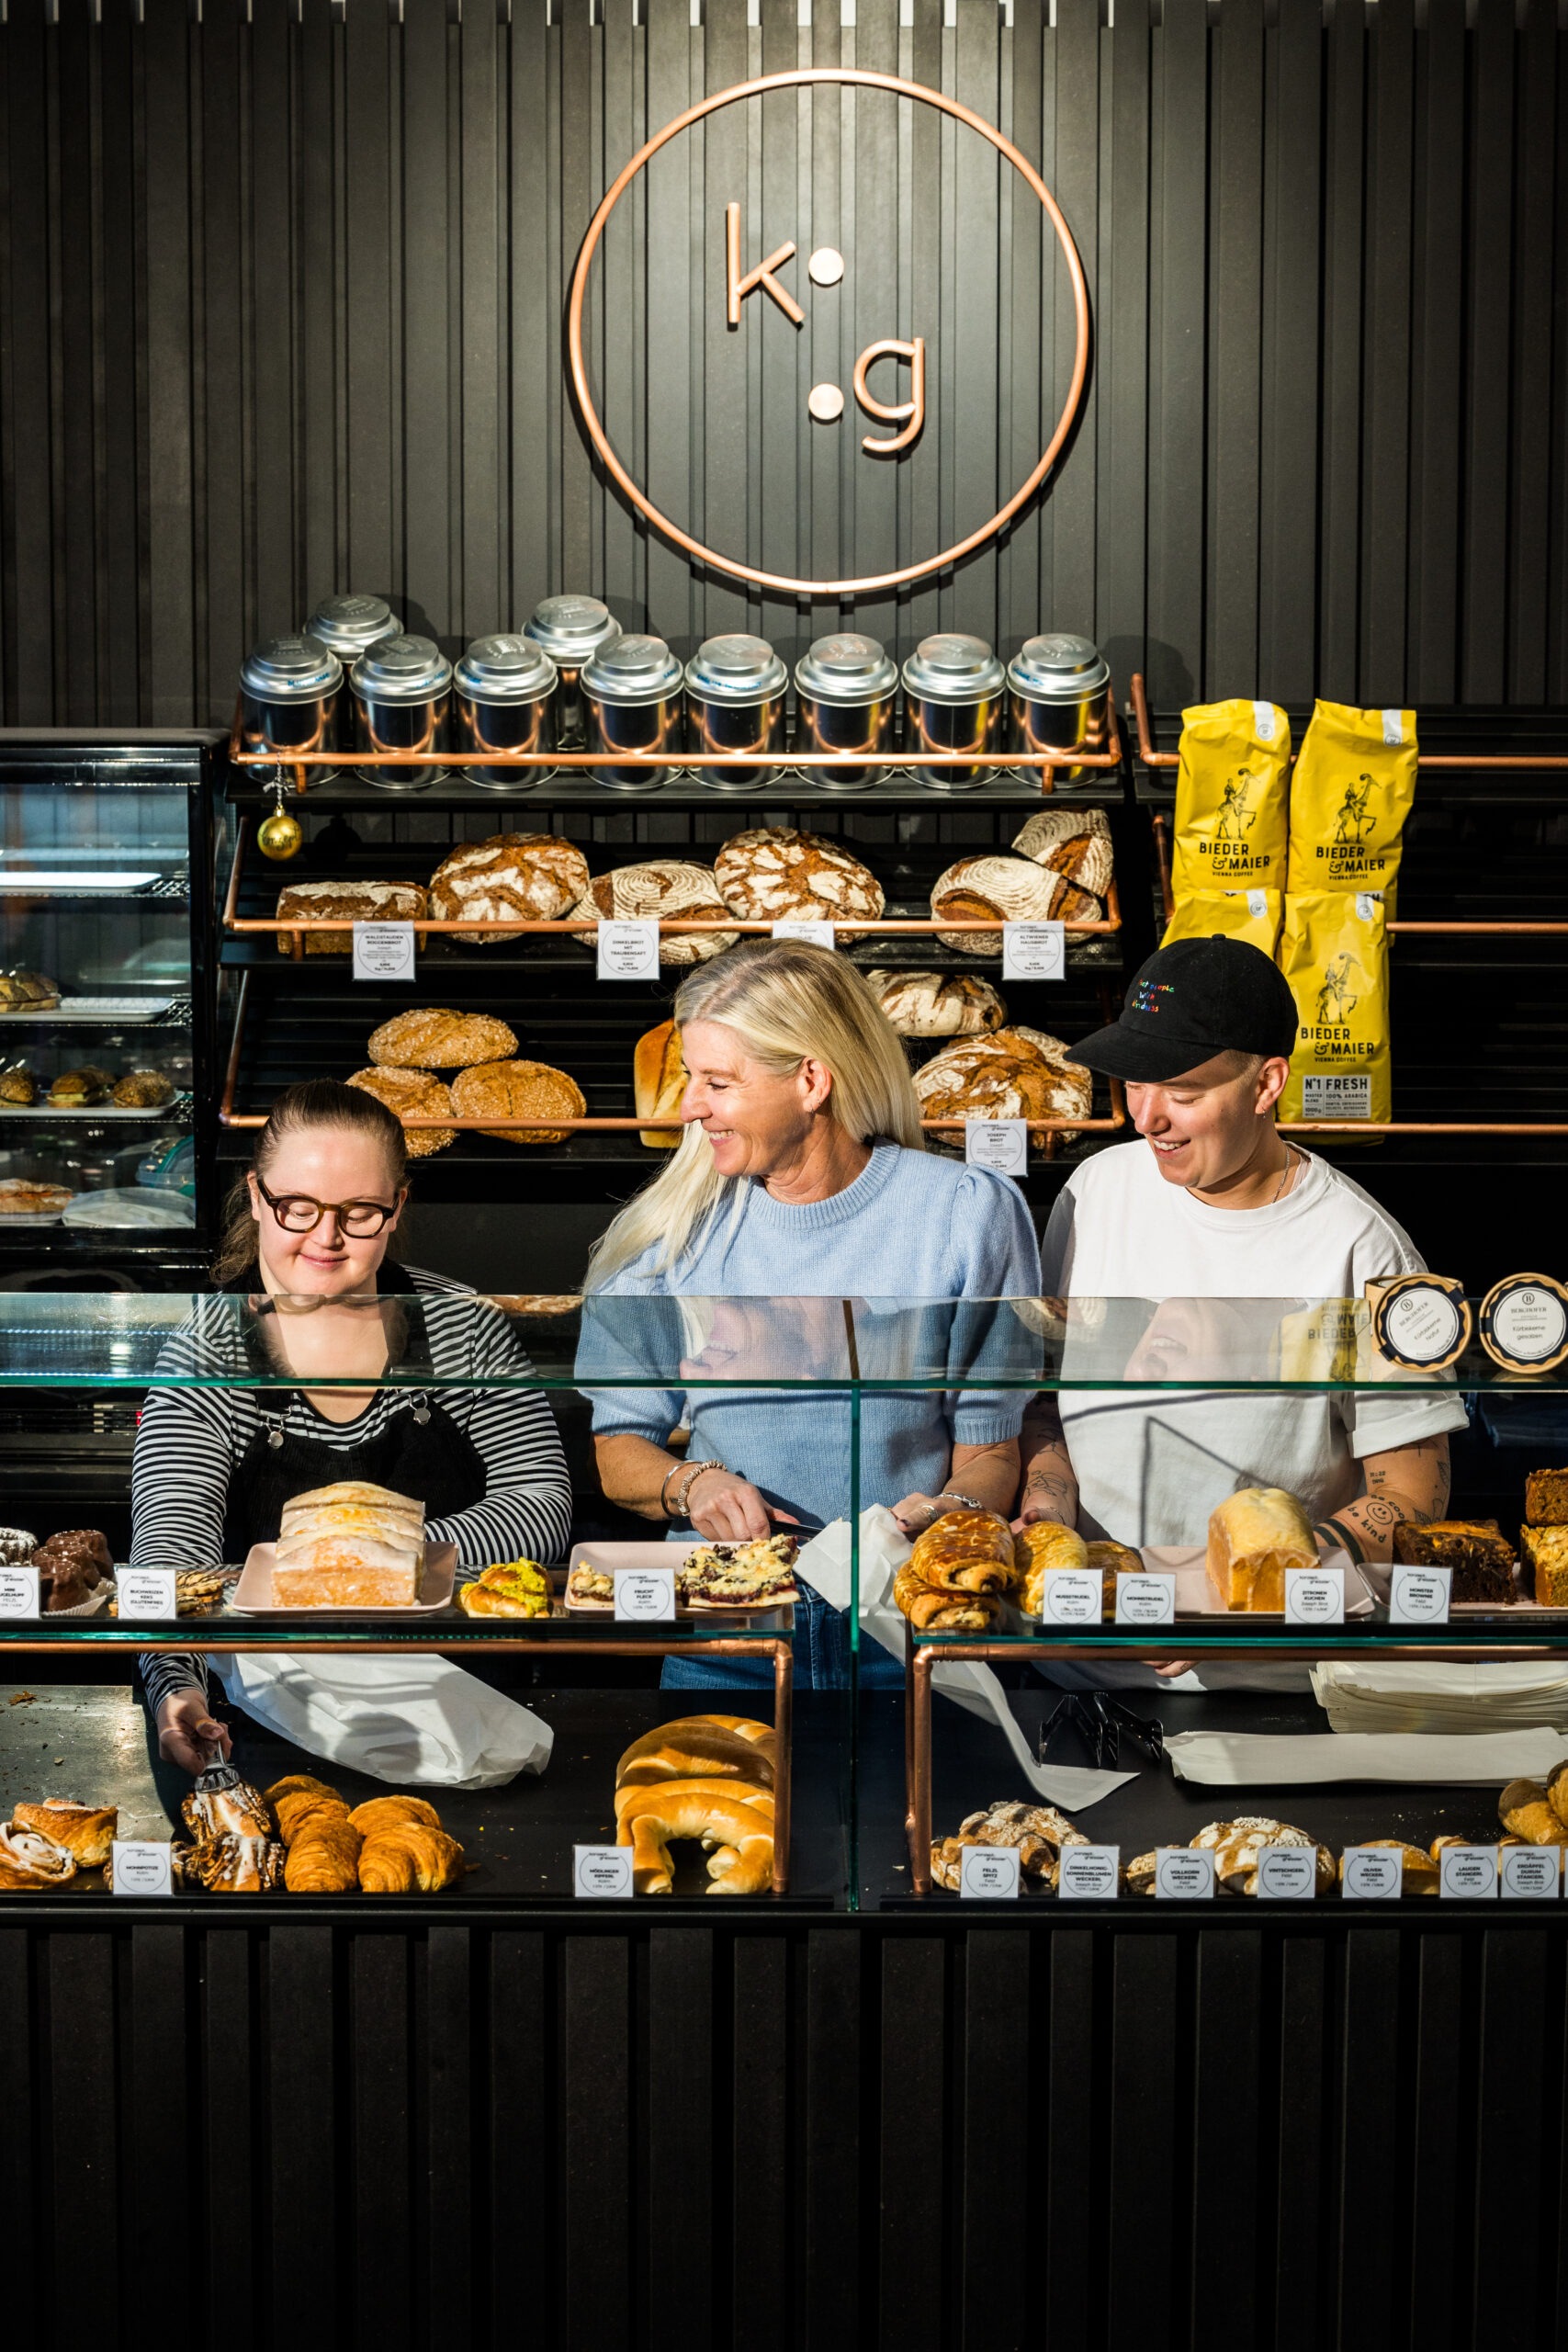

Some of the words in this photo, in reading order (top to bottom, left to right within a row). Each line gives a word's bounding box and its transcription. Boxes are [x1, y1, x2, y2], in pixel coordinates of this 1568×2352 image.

[1200, 842, 1248, 855] BIEDER
[1316, 846, 1364, 859] BIEDER
[1302, 1028, 1349, 1040] BIEDER
[1326, 1078, 1367, 1090] FRESH
[1361, 1520, 1386, 1544] kind
